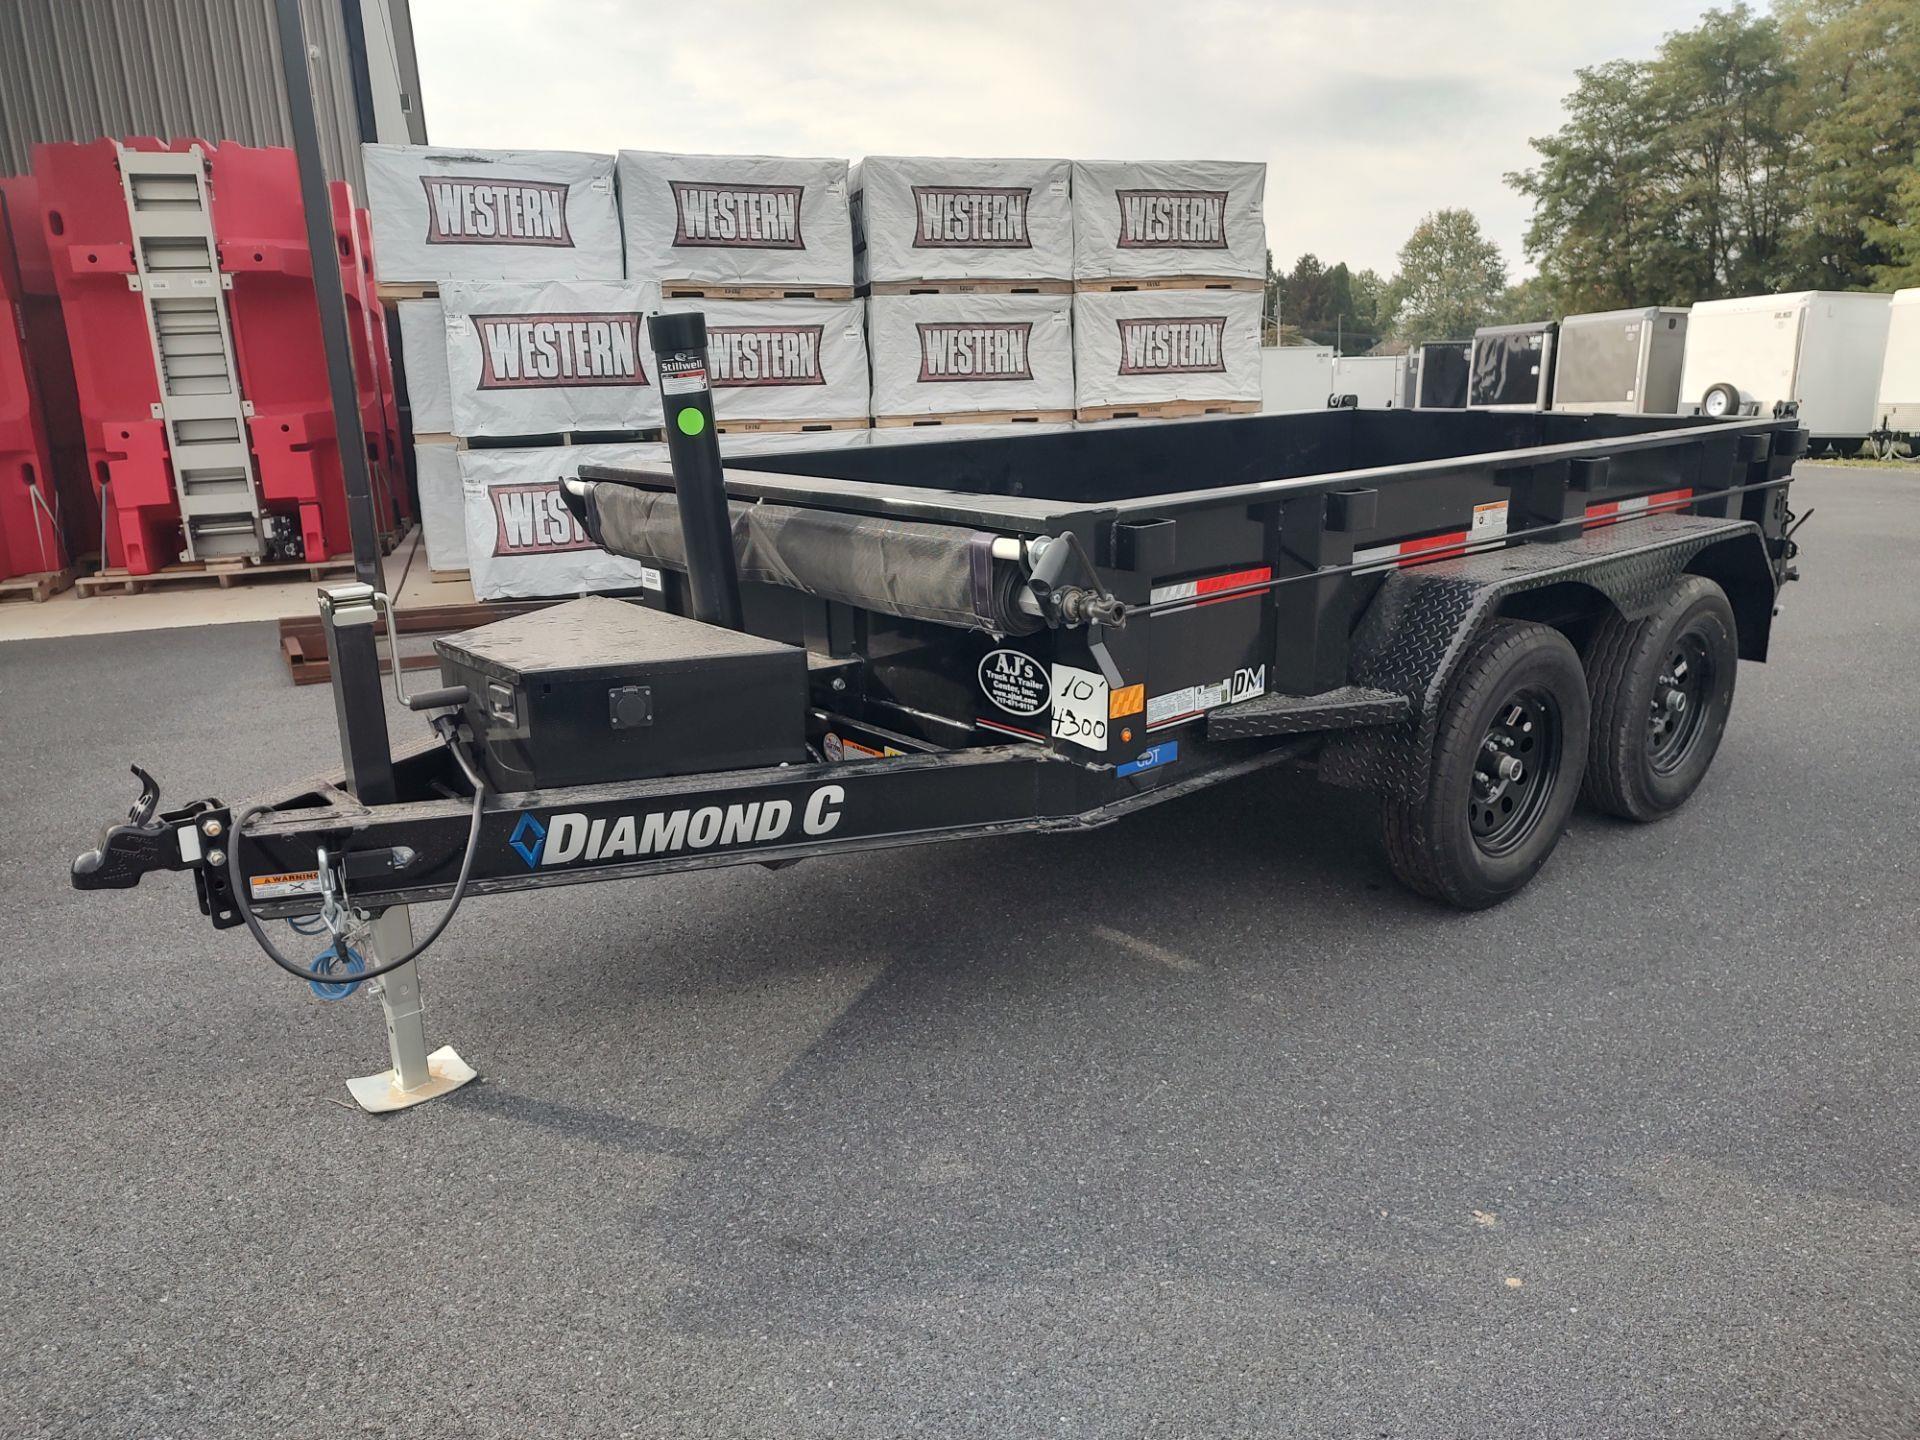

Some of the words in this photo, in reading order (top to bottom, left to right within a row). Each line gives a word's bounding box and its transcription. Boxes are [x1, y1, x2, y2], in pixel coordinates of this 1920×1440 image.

[431, 183, 562, 239] WESTERN
[680, 189, 795, 242] WESTERN
[920, 193, 1023, 242] WESTERN
[1124, 195, 1220, 243] WESTERN
[484, 321, 635, 380] WESTERN
[661, 359, 703, 371] Stillwell
[706, 332, 816, 379] WESTERN
[923, 328, 1025, 375] WESTERN
[1123, 323, 1217, 369] WESTERN
[986, 669, 1008, 682] Truck
[1017, 677, 1043, 689] Trailer
[995, 653, 1034, 678] AJ's
[1232, 664, 1265, 697] DM
[803, 784, 845, 836] C
